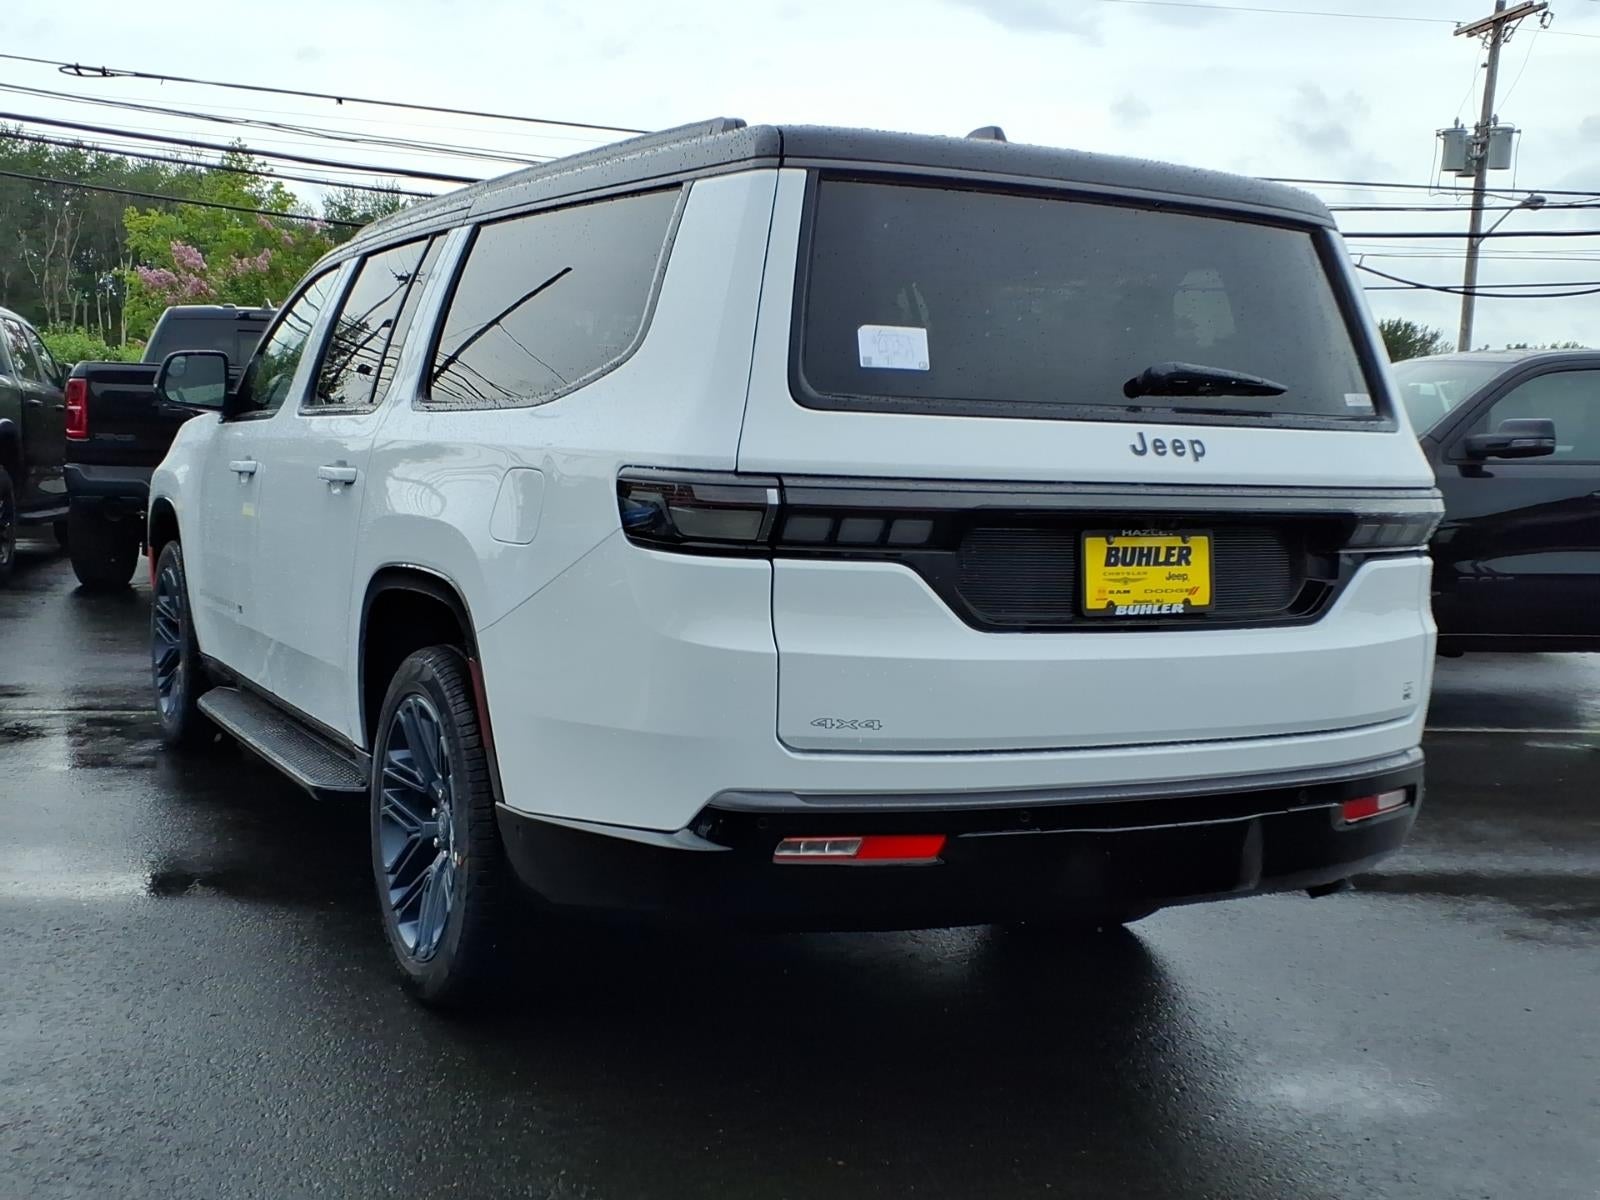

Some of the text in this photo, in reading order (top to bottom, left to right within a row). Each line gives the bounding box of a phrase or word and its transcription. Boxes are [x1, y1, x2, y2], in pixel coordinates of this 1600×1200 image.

[1129, 431, 1206, 462] Jeep
[1104, 546, 1192, 567] BUHLER
[1165, 571, 1189, 583] Jeep
[1115, 603, 1184, 616] BUHLER
